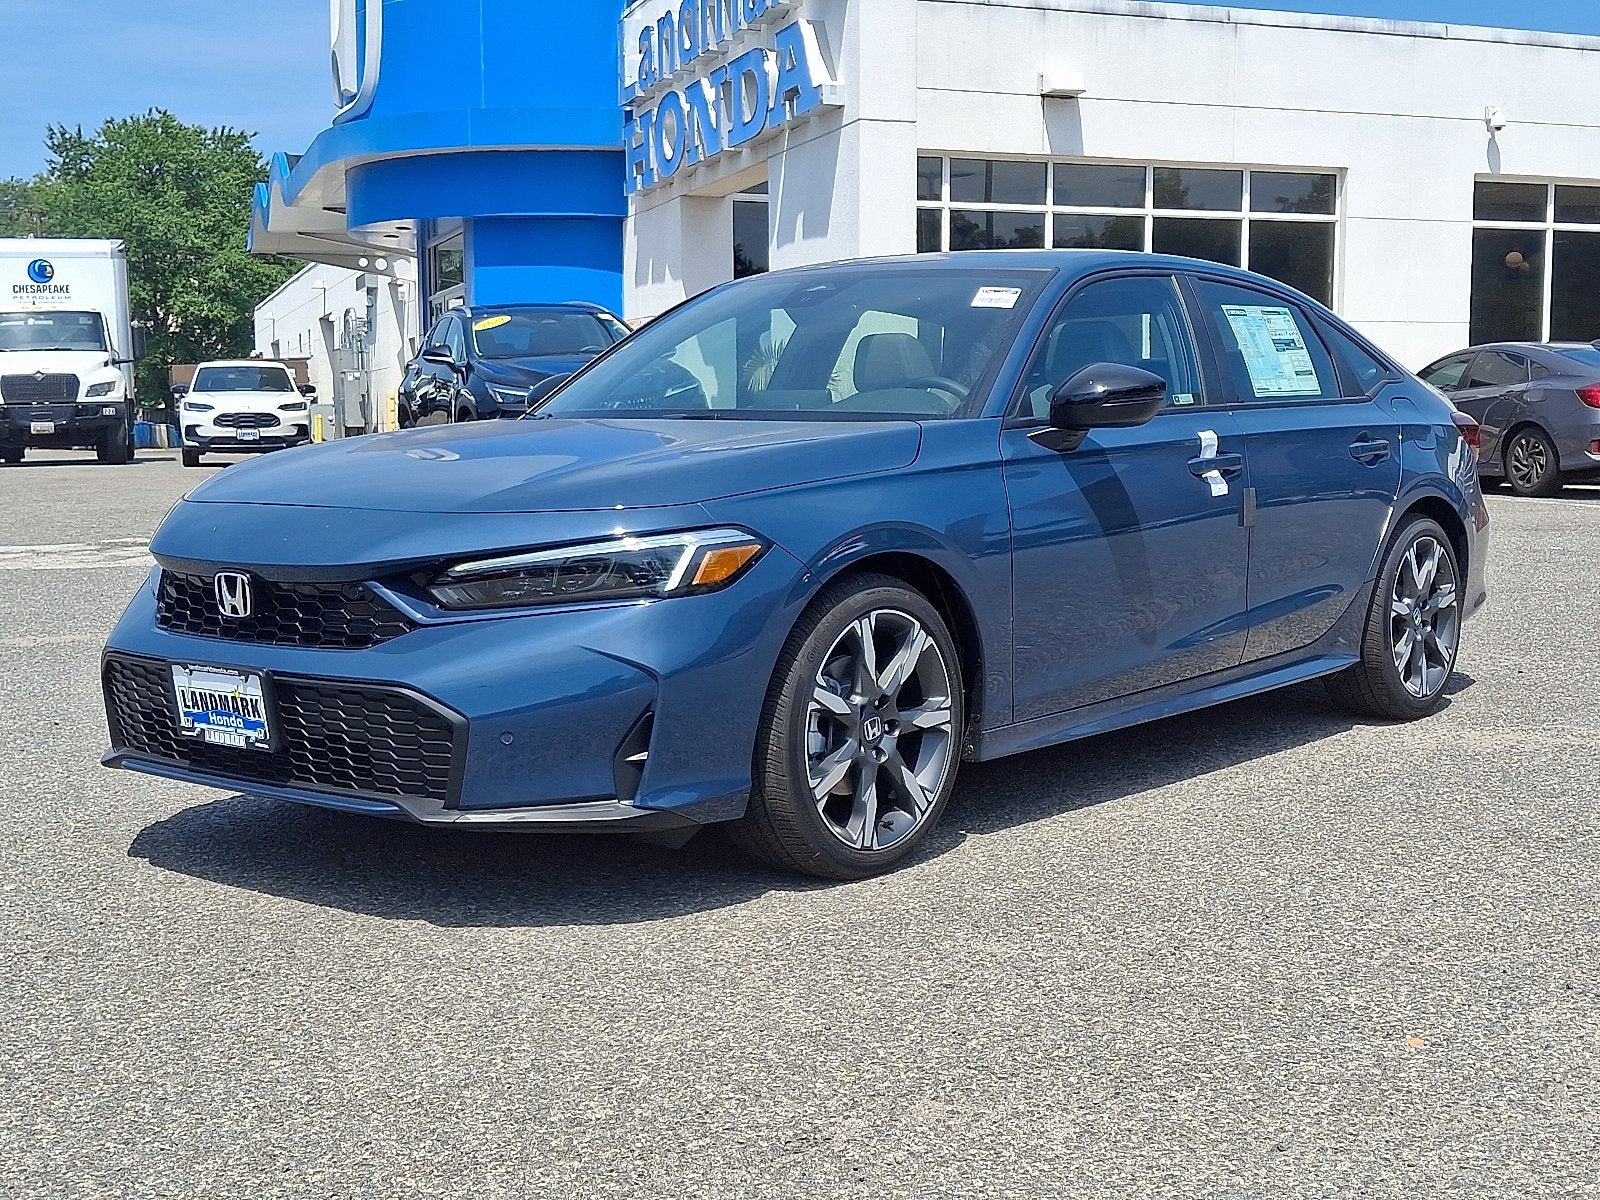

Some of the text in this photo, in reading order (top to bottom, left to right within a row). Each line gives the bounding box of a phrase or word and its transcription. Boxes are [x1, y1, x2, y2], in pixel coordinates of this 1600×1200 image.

[623, 18, 828, 197] HONDA
[12, 284, 71, 294] CHESAPEAKE
[180, 689, 263, 719] LANDMARK
[208, 711, 245, 728] Honda
